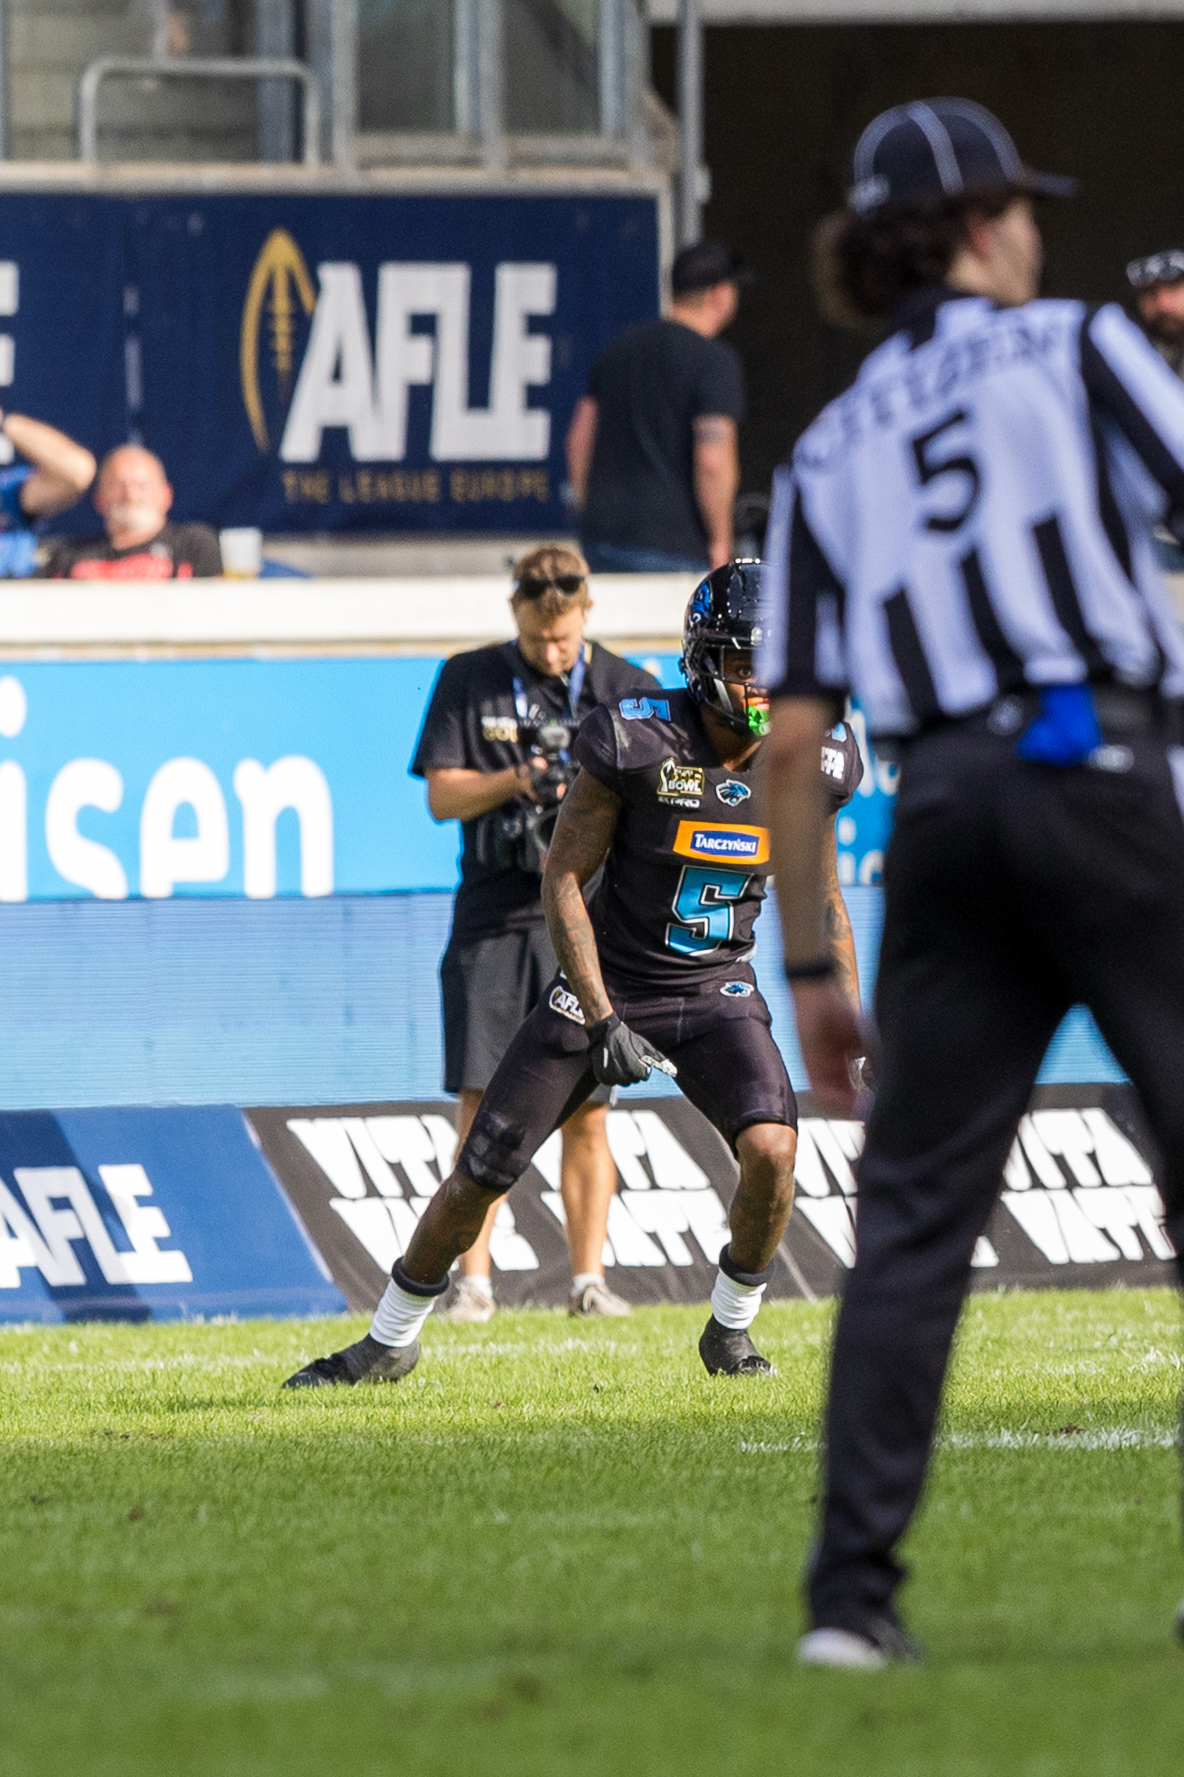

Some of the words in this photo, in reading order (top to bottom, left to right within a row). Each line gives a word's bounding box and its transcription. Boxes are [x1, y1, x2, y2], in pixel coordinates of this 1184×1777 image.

[280, 262, 557, 462] AFLE
[908, 410, 981, 532] 5
[668, 780, 702, 793] BOWL
[694, 833, 757, 854] TARCZYŃSKI
[665, 865, 754, 956] 5
